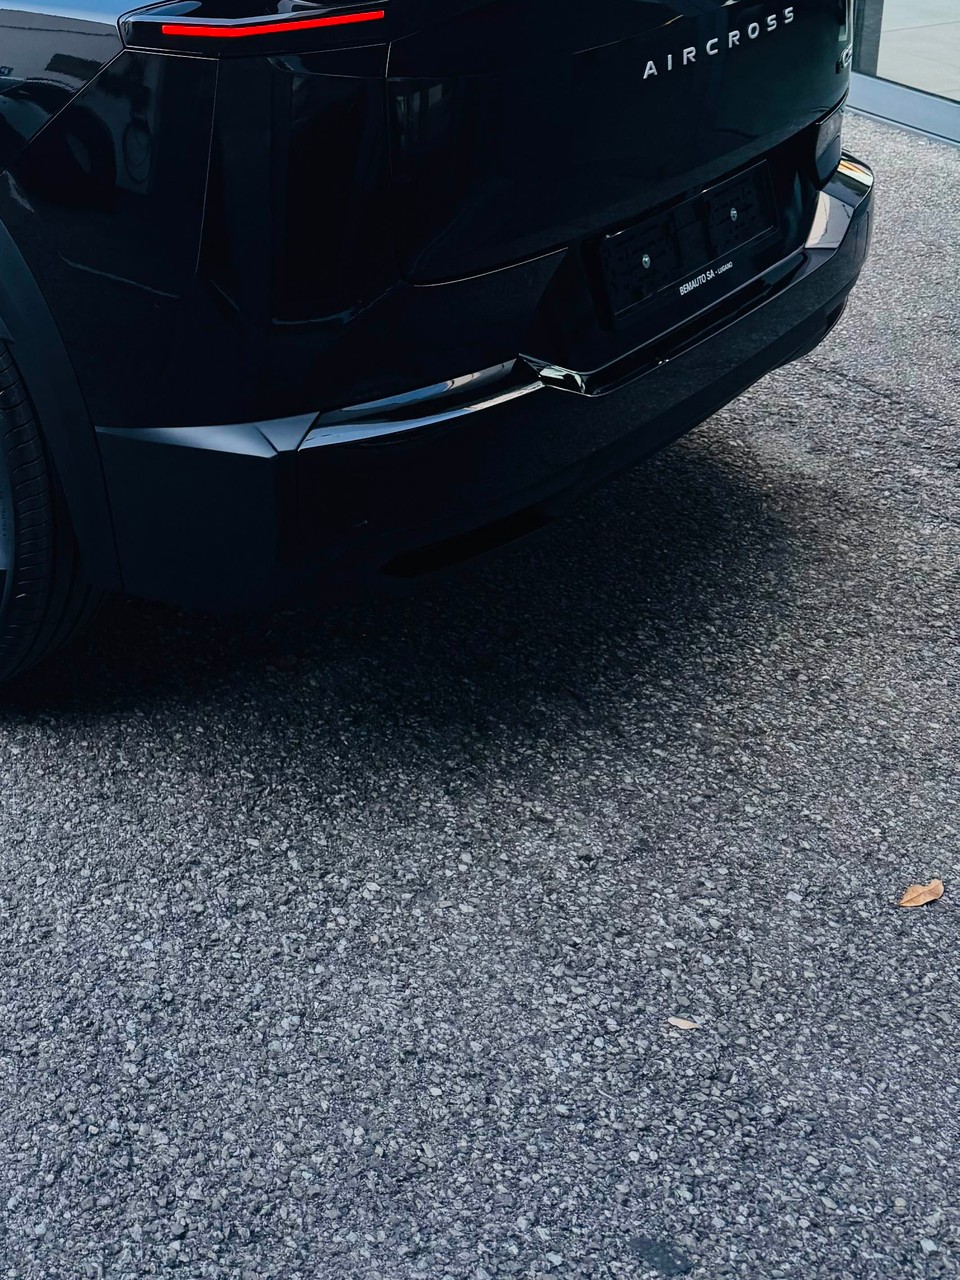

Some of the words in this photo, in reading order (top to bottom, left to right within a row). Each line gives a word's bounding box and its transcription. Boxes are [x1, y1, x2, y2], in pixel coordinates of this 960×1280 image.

[642, 6, 795, 80] AIRCROSS
[679, 273, 707, 296] BEMAUTO
[706, 269, 716, 280] SA
